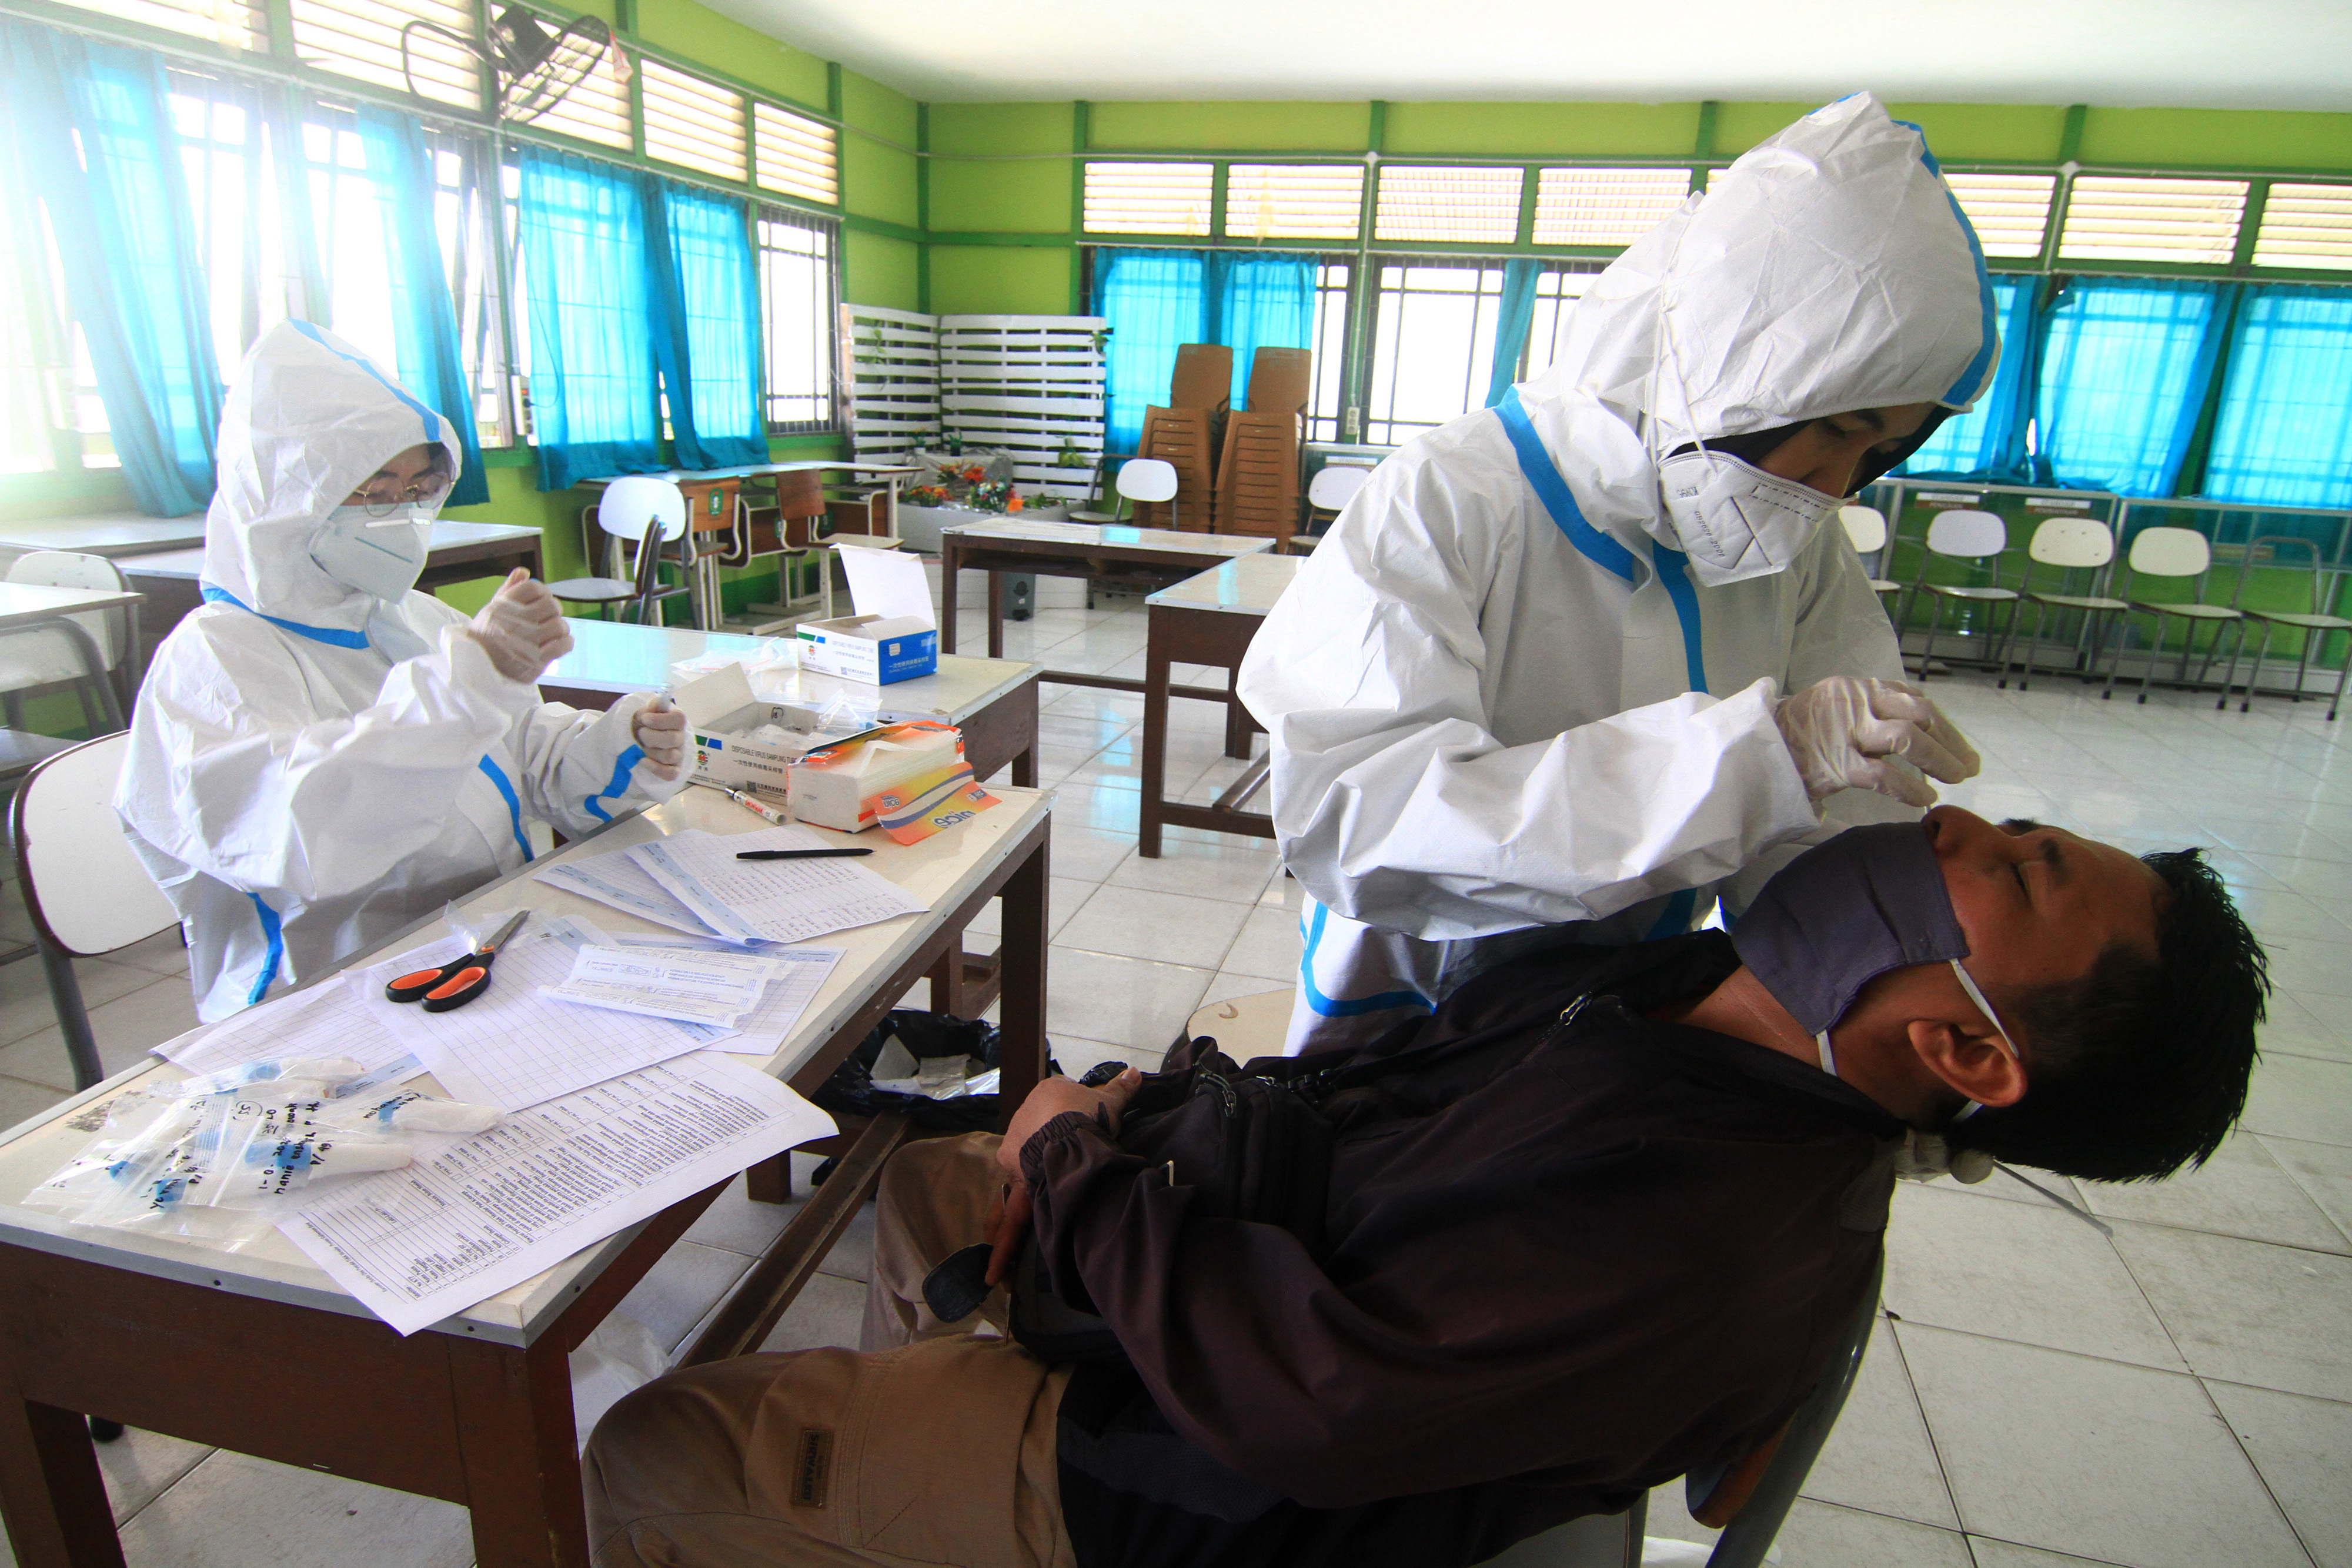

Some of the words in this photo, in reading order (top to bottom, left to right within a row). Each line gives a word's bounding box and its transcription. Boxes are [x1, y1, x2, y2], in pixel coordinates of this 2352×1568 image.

[731, 745, 754, 757] DISPOSABLE
[755, 750, 766, 758] VIRUS
[766, 752, 786, 763] SAMPLING
